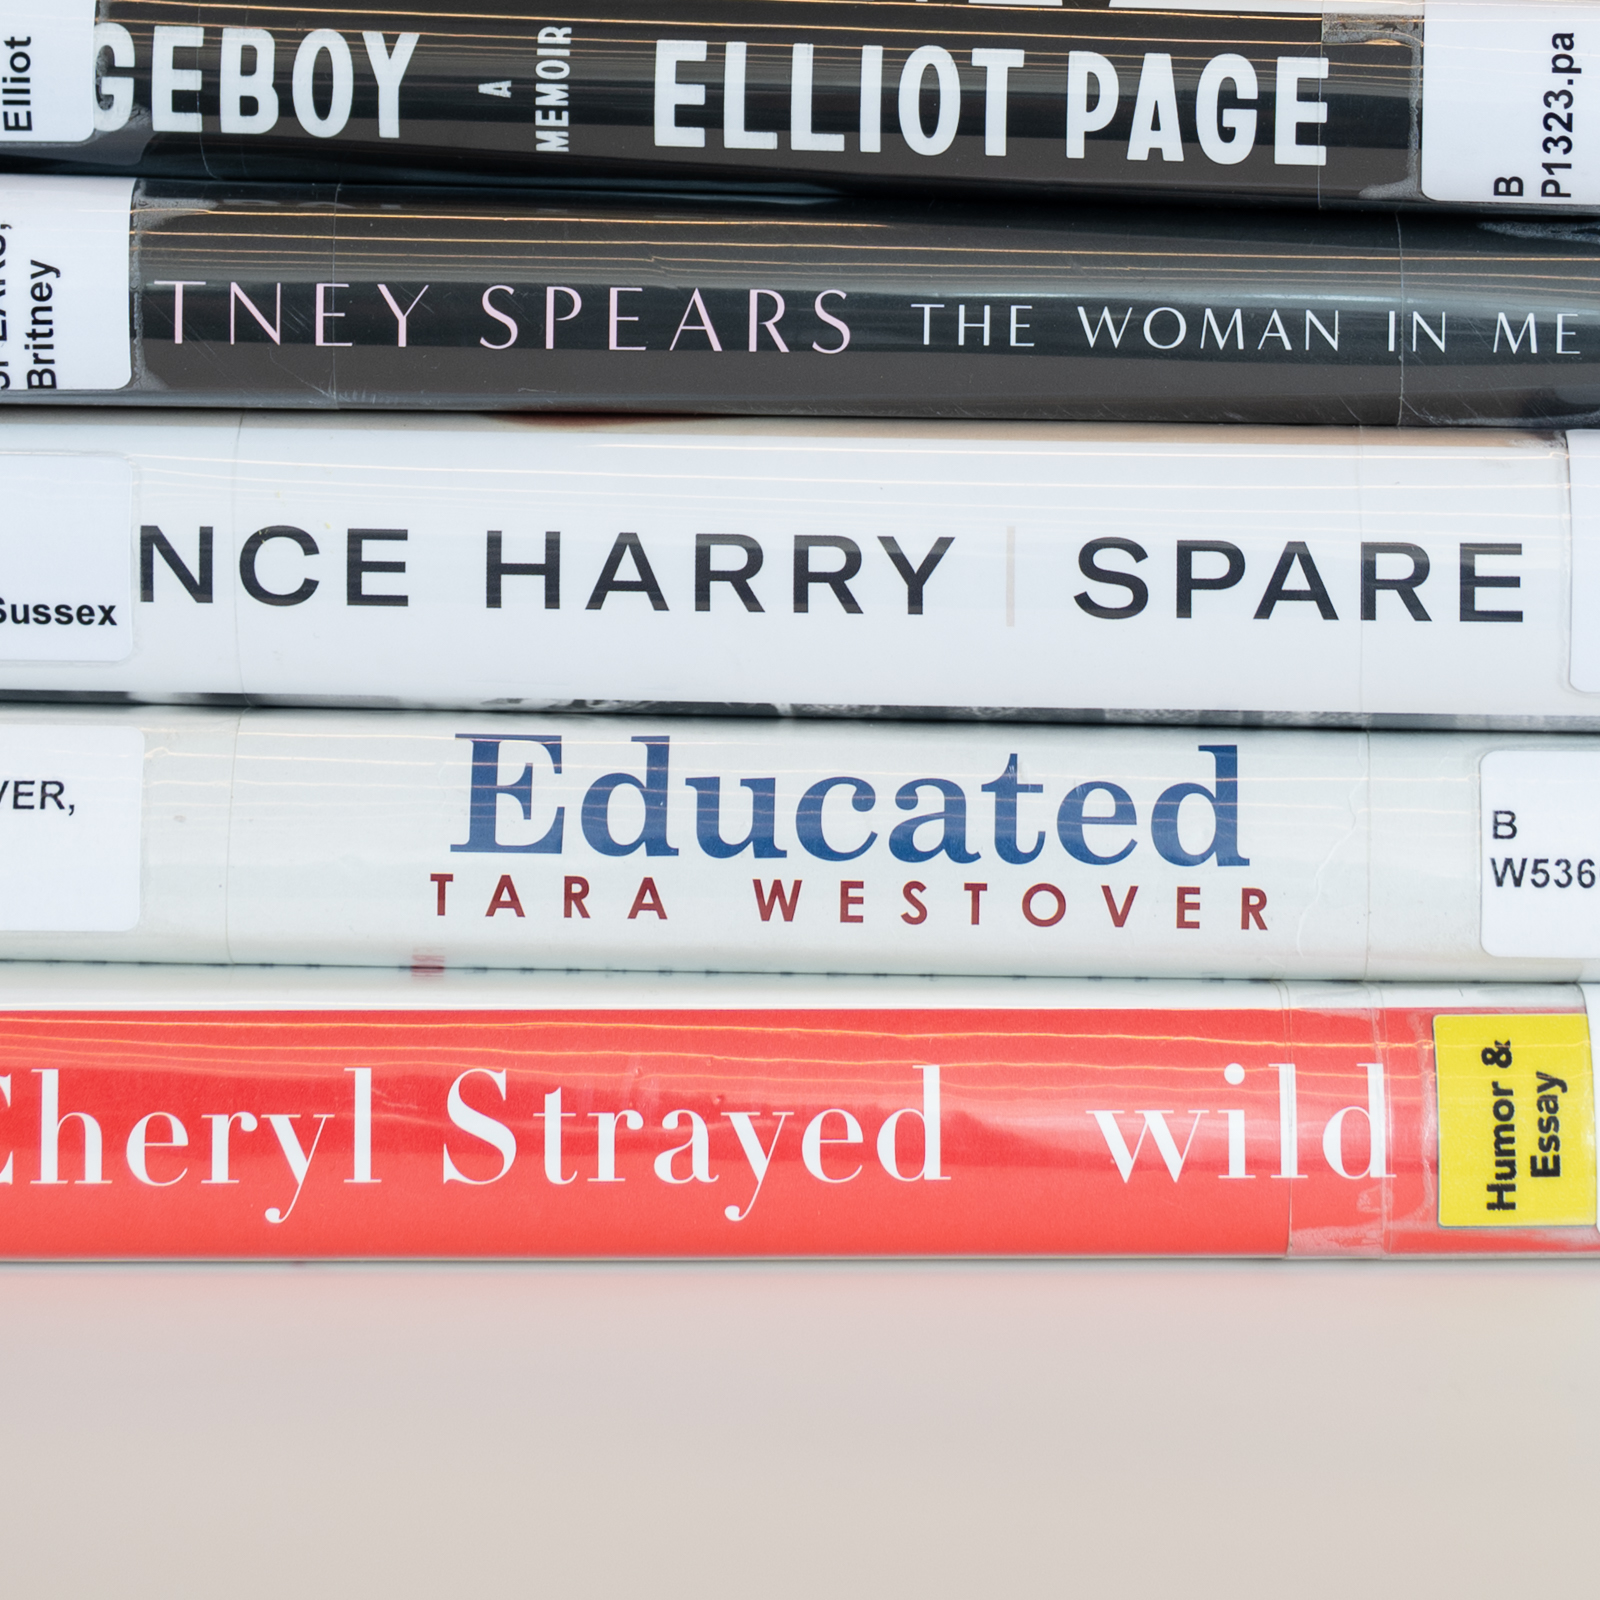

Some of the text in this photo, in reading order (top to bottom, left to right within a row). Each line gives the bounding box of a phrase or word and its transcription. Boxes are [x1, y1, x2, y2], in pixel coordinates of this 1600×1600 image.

[2, 37, 32, 131] Elliot
[478, 81, 511, 97] A
[534, 25, 572, 152] MEMOIR
[654, 39, 1330, 167] ELLIOT PAGE
[1541, 32, 1581, 198] P1323.pa
[1494, 177, 1523, 196] B
[25, 258, 62, 391] Britney
[153, 280, 1582, 356] TNEY SPEARS THE WOMAN IN ME
[140, 526, 1523, 622] NCE HARRY SPARE
[450, 732, 1251, 868] Educated
[1493, 811, 1517, 839] B
[431, 874, 1267, 930] TARA WESTOVER
[442, 1064, 953, 1222] Strayed
[1085, 1062, 1398, 1184] wild
[1480, 1039, 1517, 1212] Humor &
[1529, 1071, 1568, 1180] Essay
